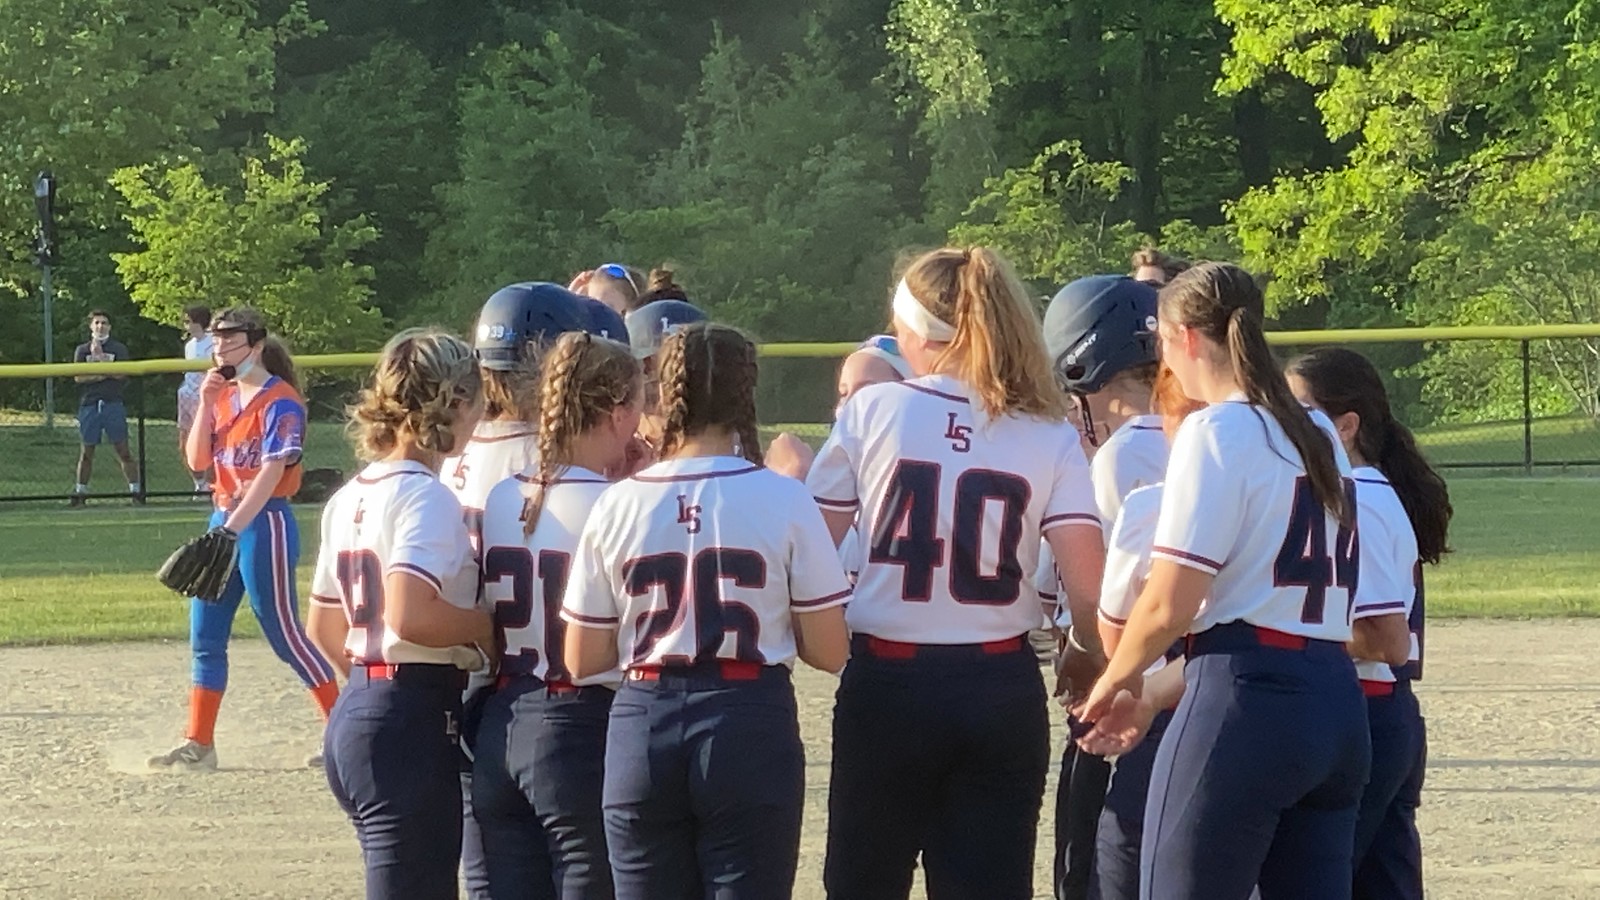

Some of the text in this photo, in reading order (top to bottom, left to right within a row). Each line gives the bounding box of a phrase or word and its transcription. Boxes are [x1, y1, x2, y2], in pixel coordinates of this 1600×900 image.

[944, 412, 973, 453] LS
[677, 494, 703, 534] LS
[869, 458, 1032, 606] 40
[485, 545, 571, 685] 21
[621, 547, 767, 665] 26
